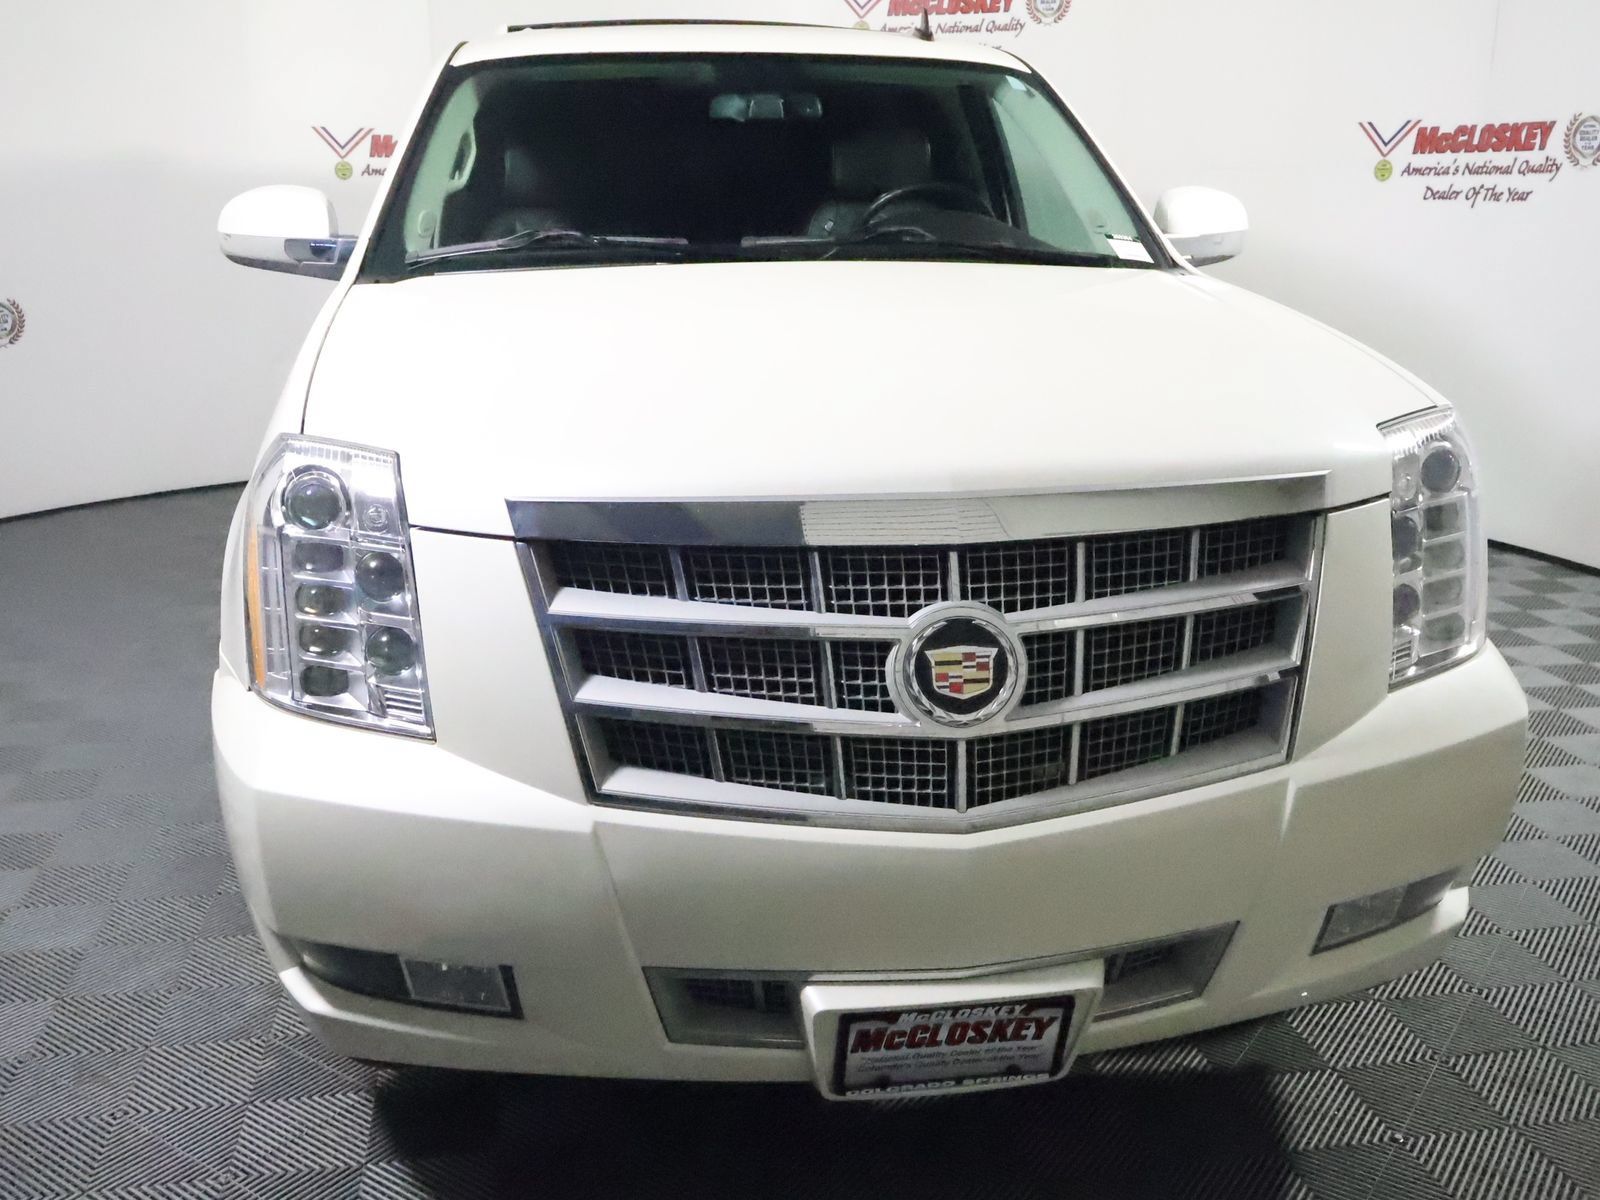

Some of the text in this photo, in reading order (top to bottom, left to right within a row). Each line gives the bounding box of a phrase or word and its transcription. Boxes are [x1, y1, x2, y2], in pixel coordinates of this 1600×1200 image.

[936, 18, 985, 35] National
[985, 17, 1026, 37] Quality
[1412, 120, 1557, 155] McCLOSKEY
[1400, 157, 1459, 177] America's
[1462, 158, 1517, 176] National
[1518, 155, 1563, 182] Quality
[1423, 184, 1533, 208] Dealer Of The Year
[898, 1003, 1028, 1024] McCLOSKEY
[850, 1016, 1060, 1053] McCLOSKEY
